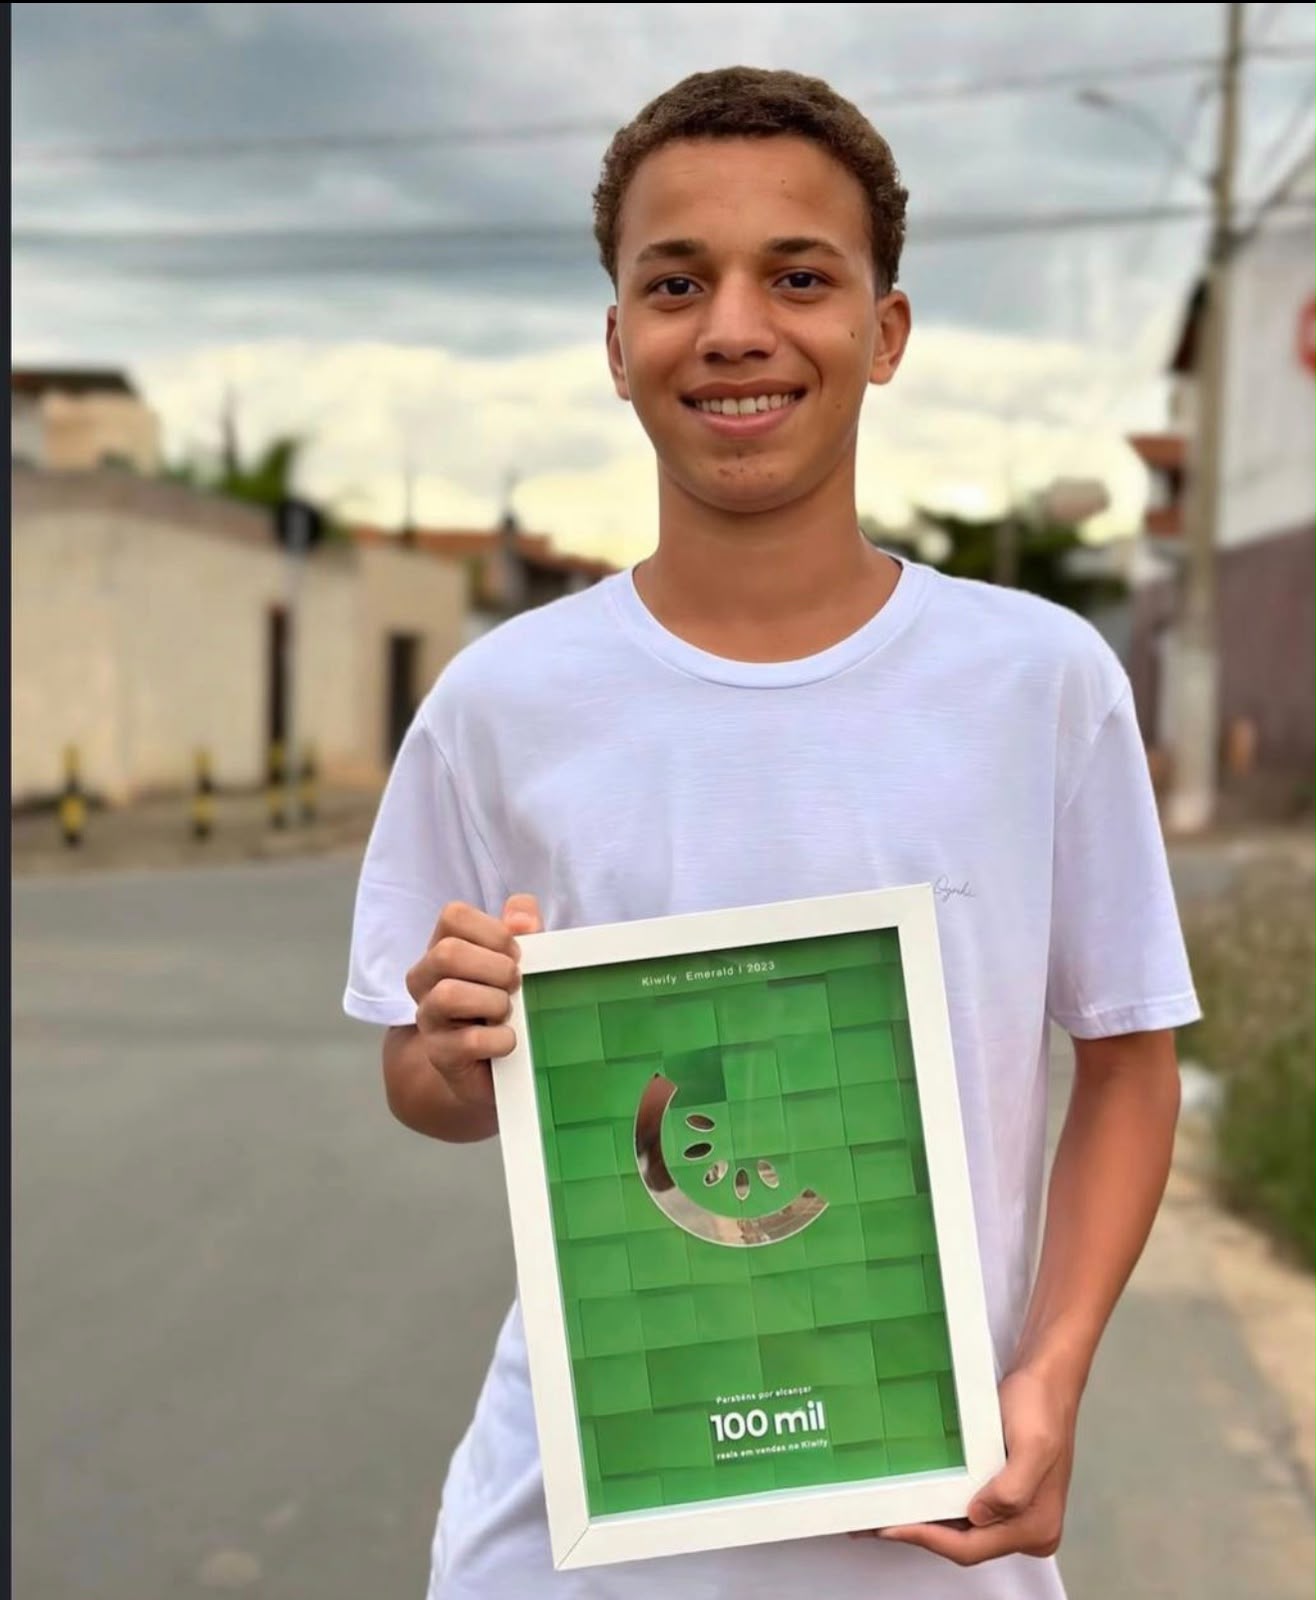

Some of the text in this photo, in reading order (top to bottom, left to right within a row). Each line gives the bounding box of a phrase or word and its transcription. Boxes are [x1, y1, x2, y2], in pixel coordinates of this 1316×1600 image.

[686, 967, 734, 981] Emerald
[747, 961, 776, 973] 2023
[758, 1391, 774, 1400] por
[710, 1400, 826, 1442] 100 mil
[740, 1449, 754, 1457] em
[755, 1445, 787, 1455] vendas
